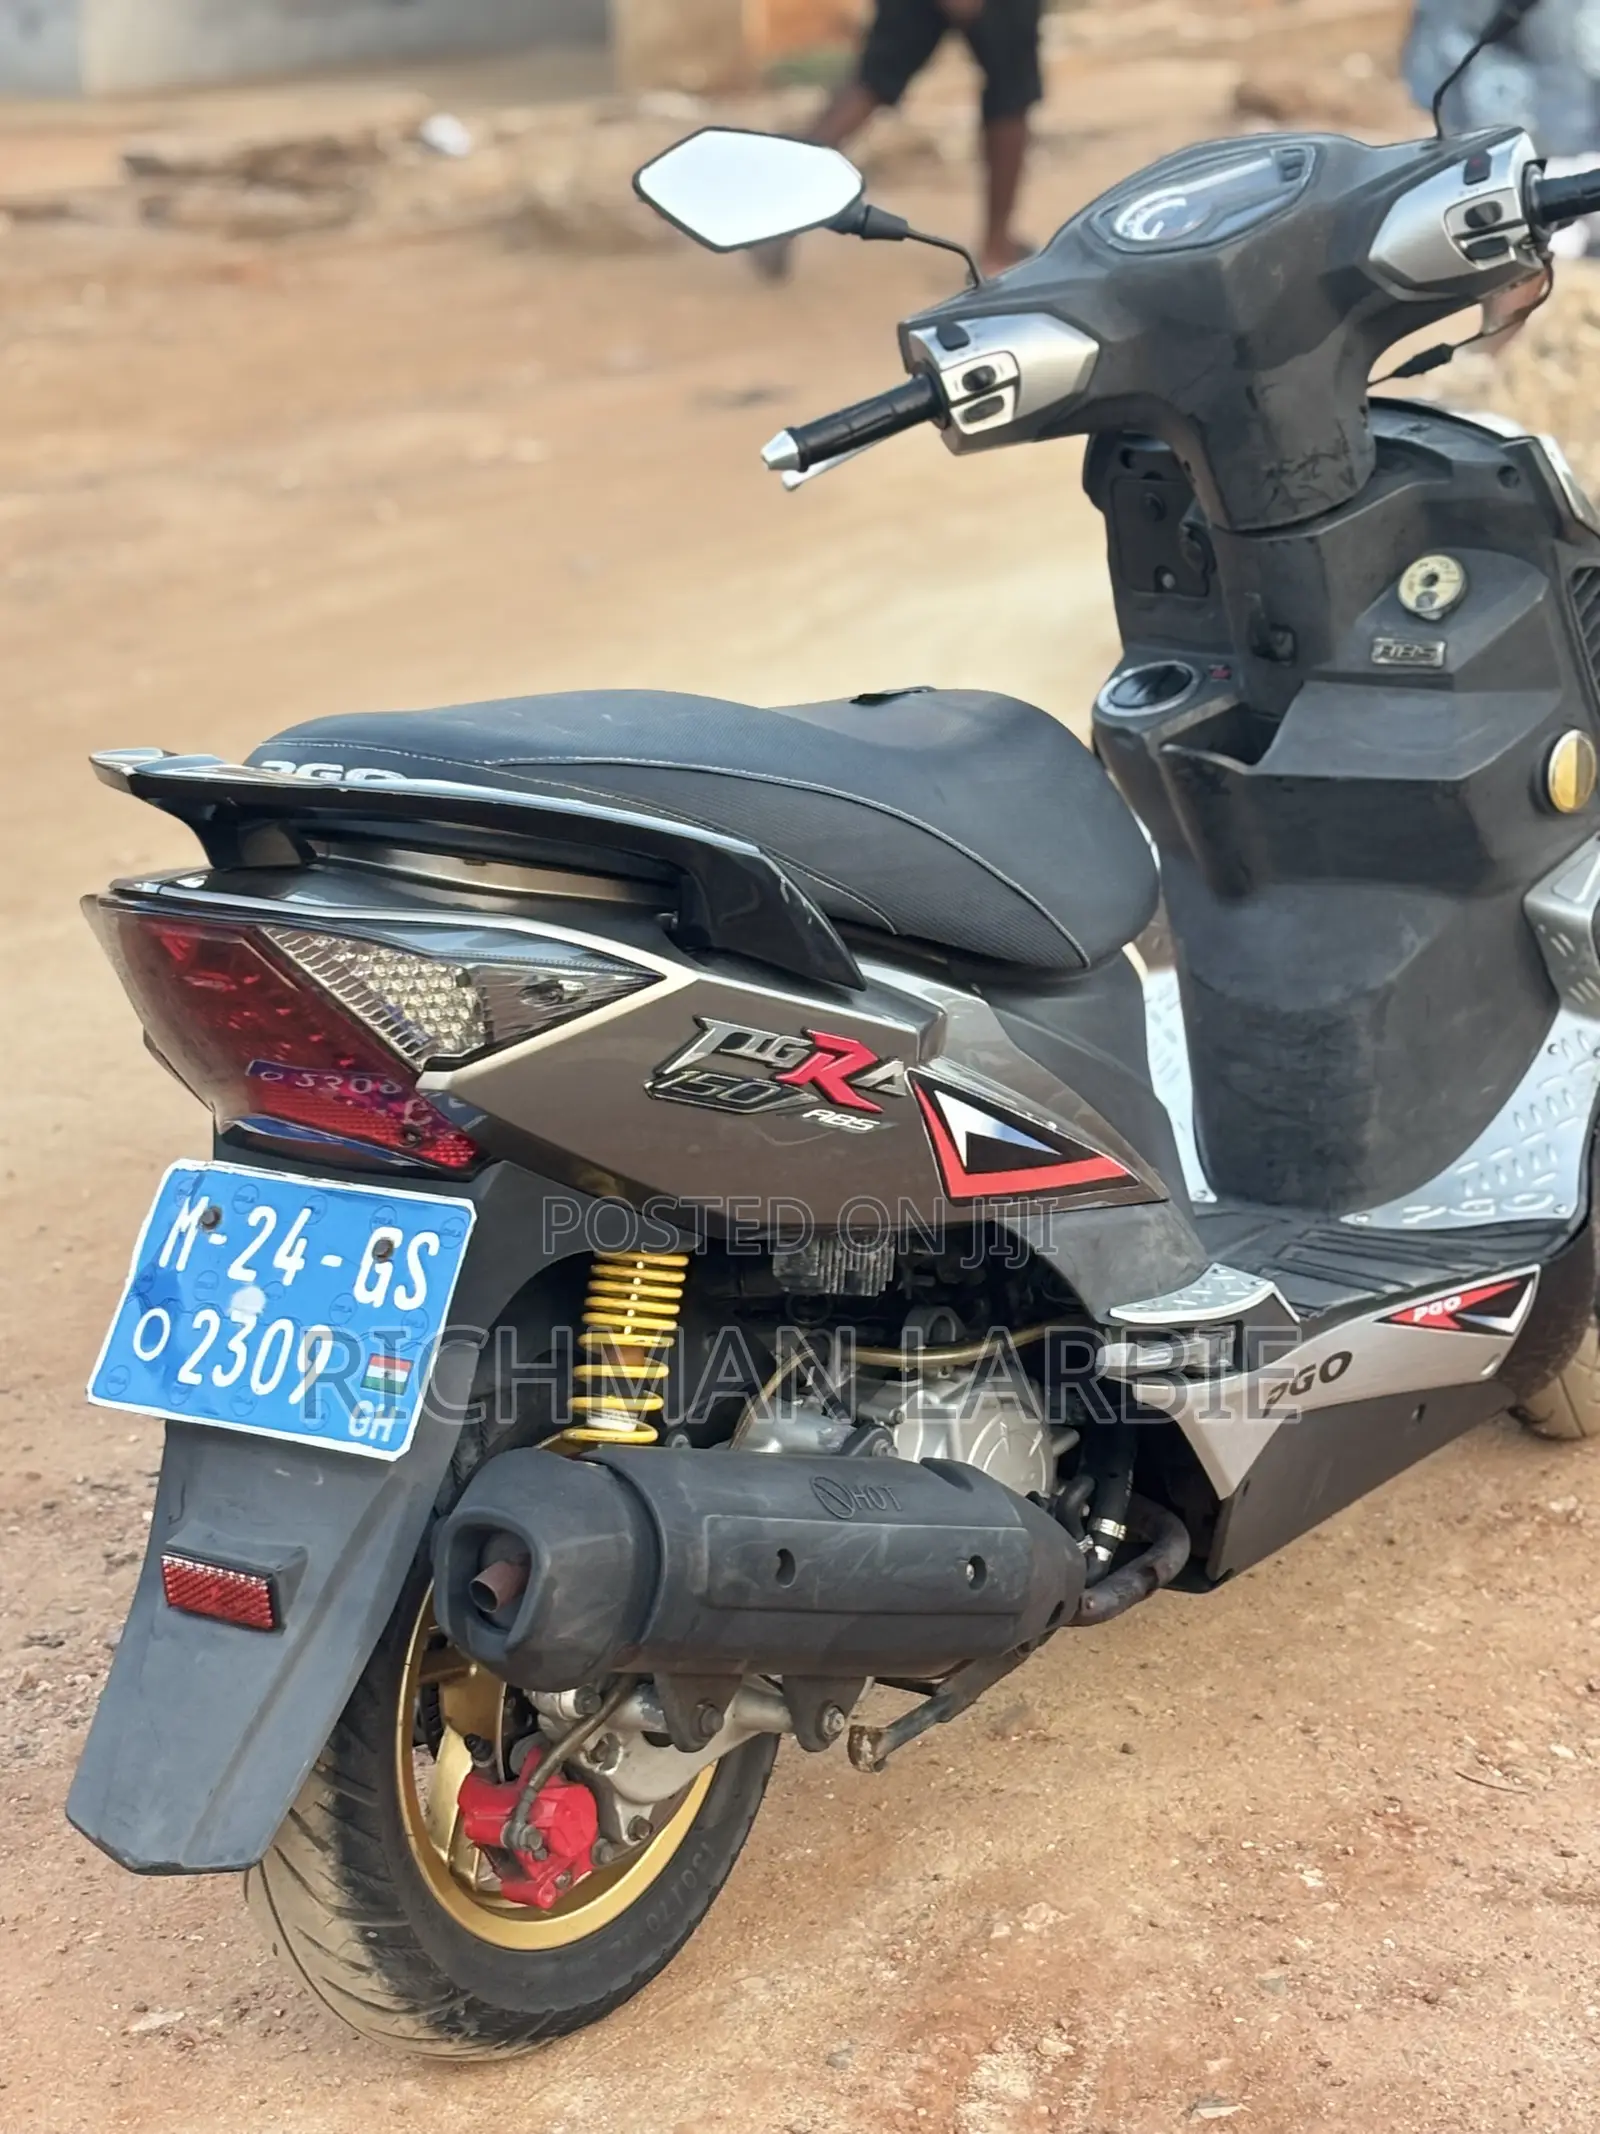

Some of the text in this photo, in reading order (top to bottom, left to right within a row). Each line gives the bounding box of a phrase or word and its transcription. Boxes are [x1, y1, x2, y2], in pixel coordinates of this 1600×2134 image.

[655, 1014, 907, 1113] TIGRA
[802, 1108, 881, 1132] ABS
[1411, 1295, 1463, 1322] PGO
[1261, 1350, 1353, 1419] PGO
[348, 1399, 398, 1443] GH
